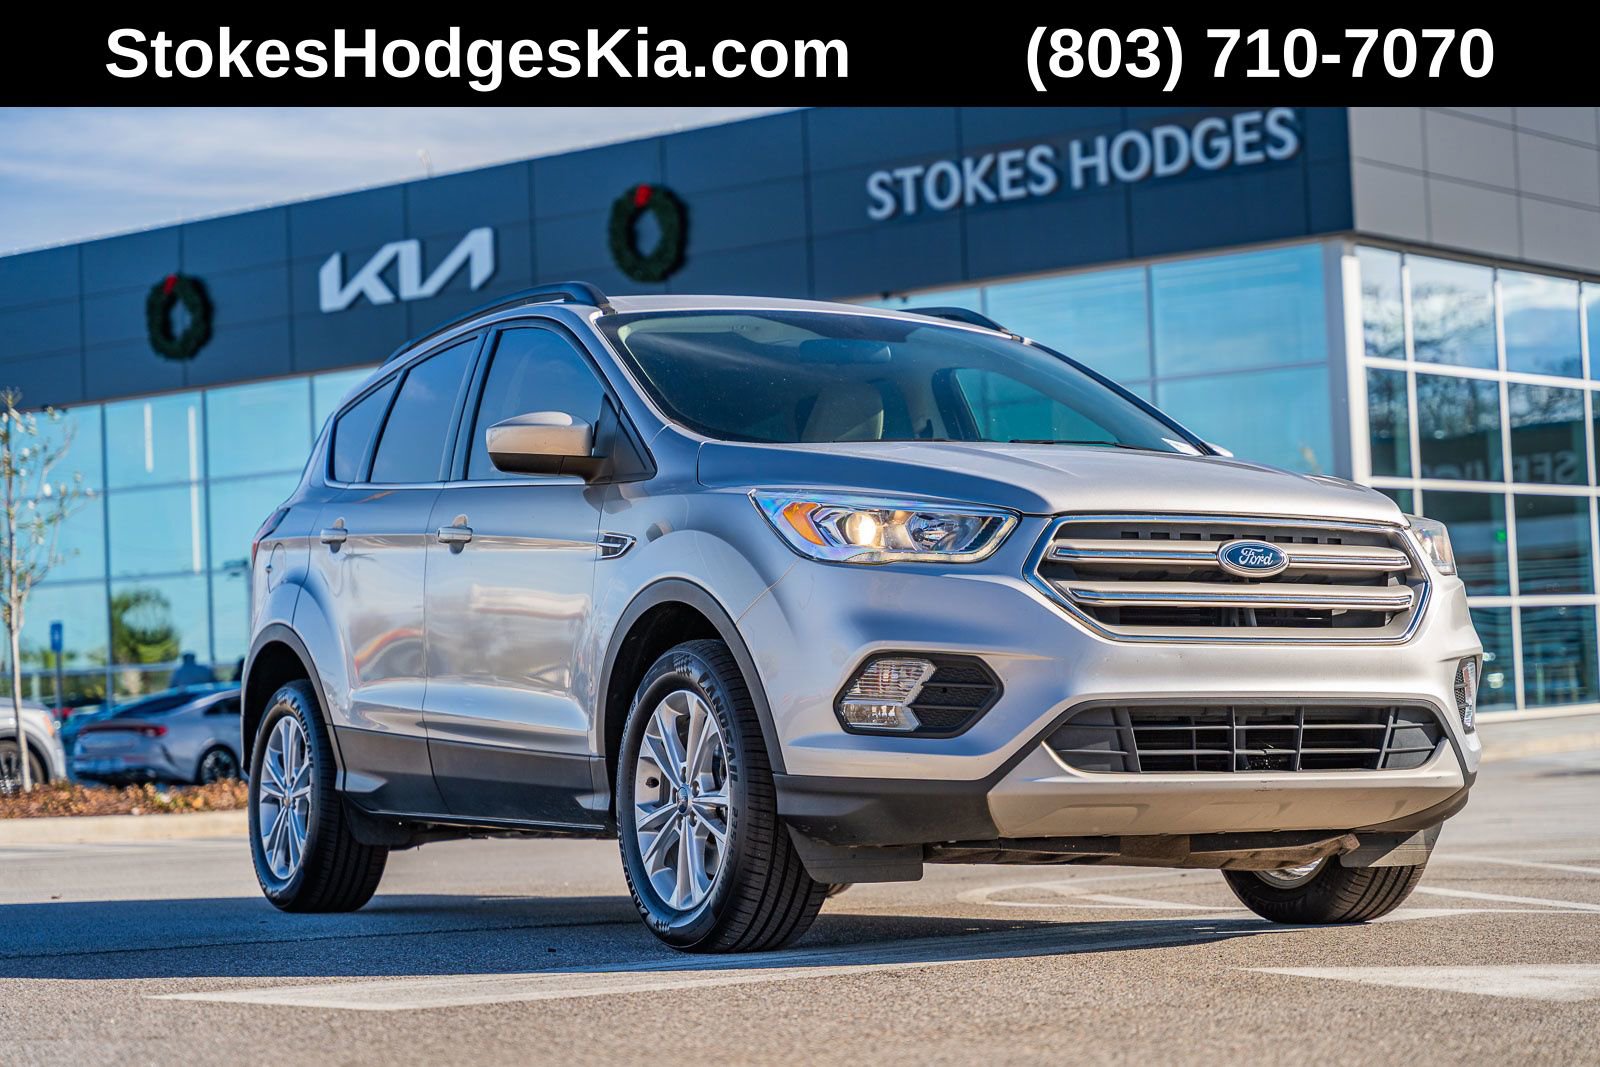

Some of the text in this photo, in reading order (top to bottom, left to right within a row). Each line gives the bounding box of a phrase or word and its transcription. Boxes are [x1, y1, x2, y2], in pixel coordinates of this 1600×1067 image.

[866, 108, 1299, 219] STOKES HODGES
[319, 227, 494, 313] KIA
[1238, 547, 1273, 566] Ford
[698, 671, 738, 788] LANDSAIL
